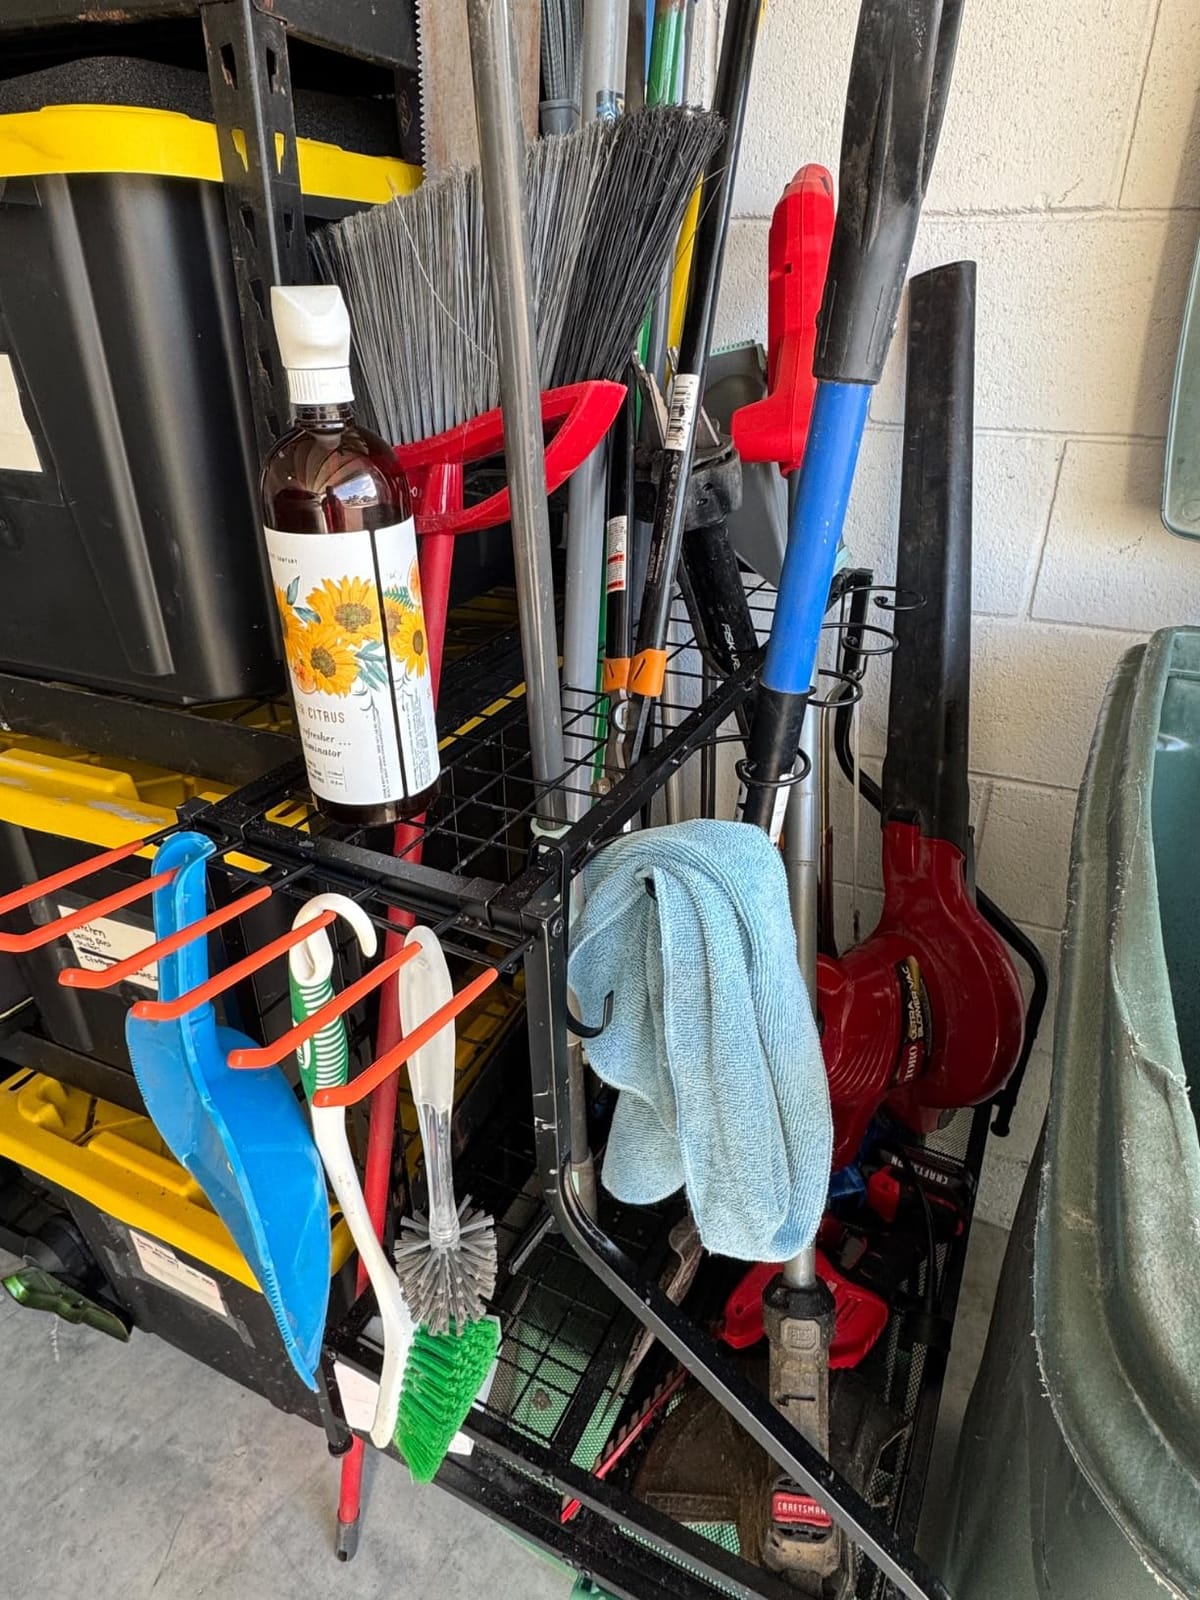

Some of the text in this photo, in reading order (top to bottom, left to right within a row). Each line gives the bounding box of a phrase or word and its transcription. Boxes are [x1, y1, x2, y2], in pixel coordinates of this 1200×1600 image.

[308, 707, 345, 724] CITRUS
[904, 1045, 918, 1082] TORO
[777, 1502, 827, 1516] CRAFTSMAN
